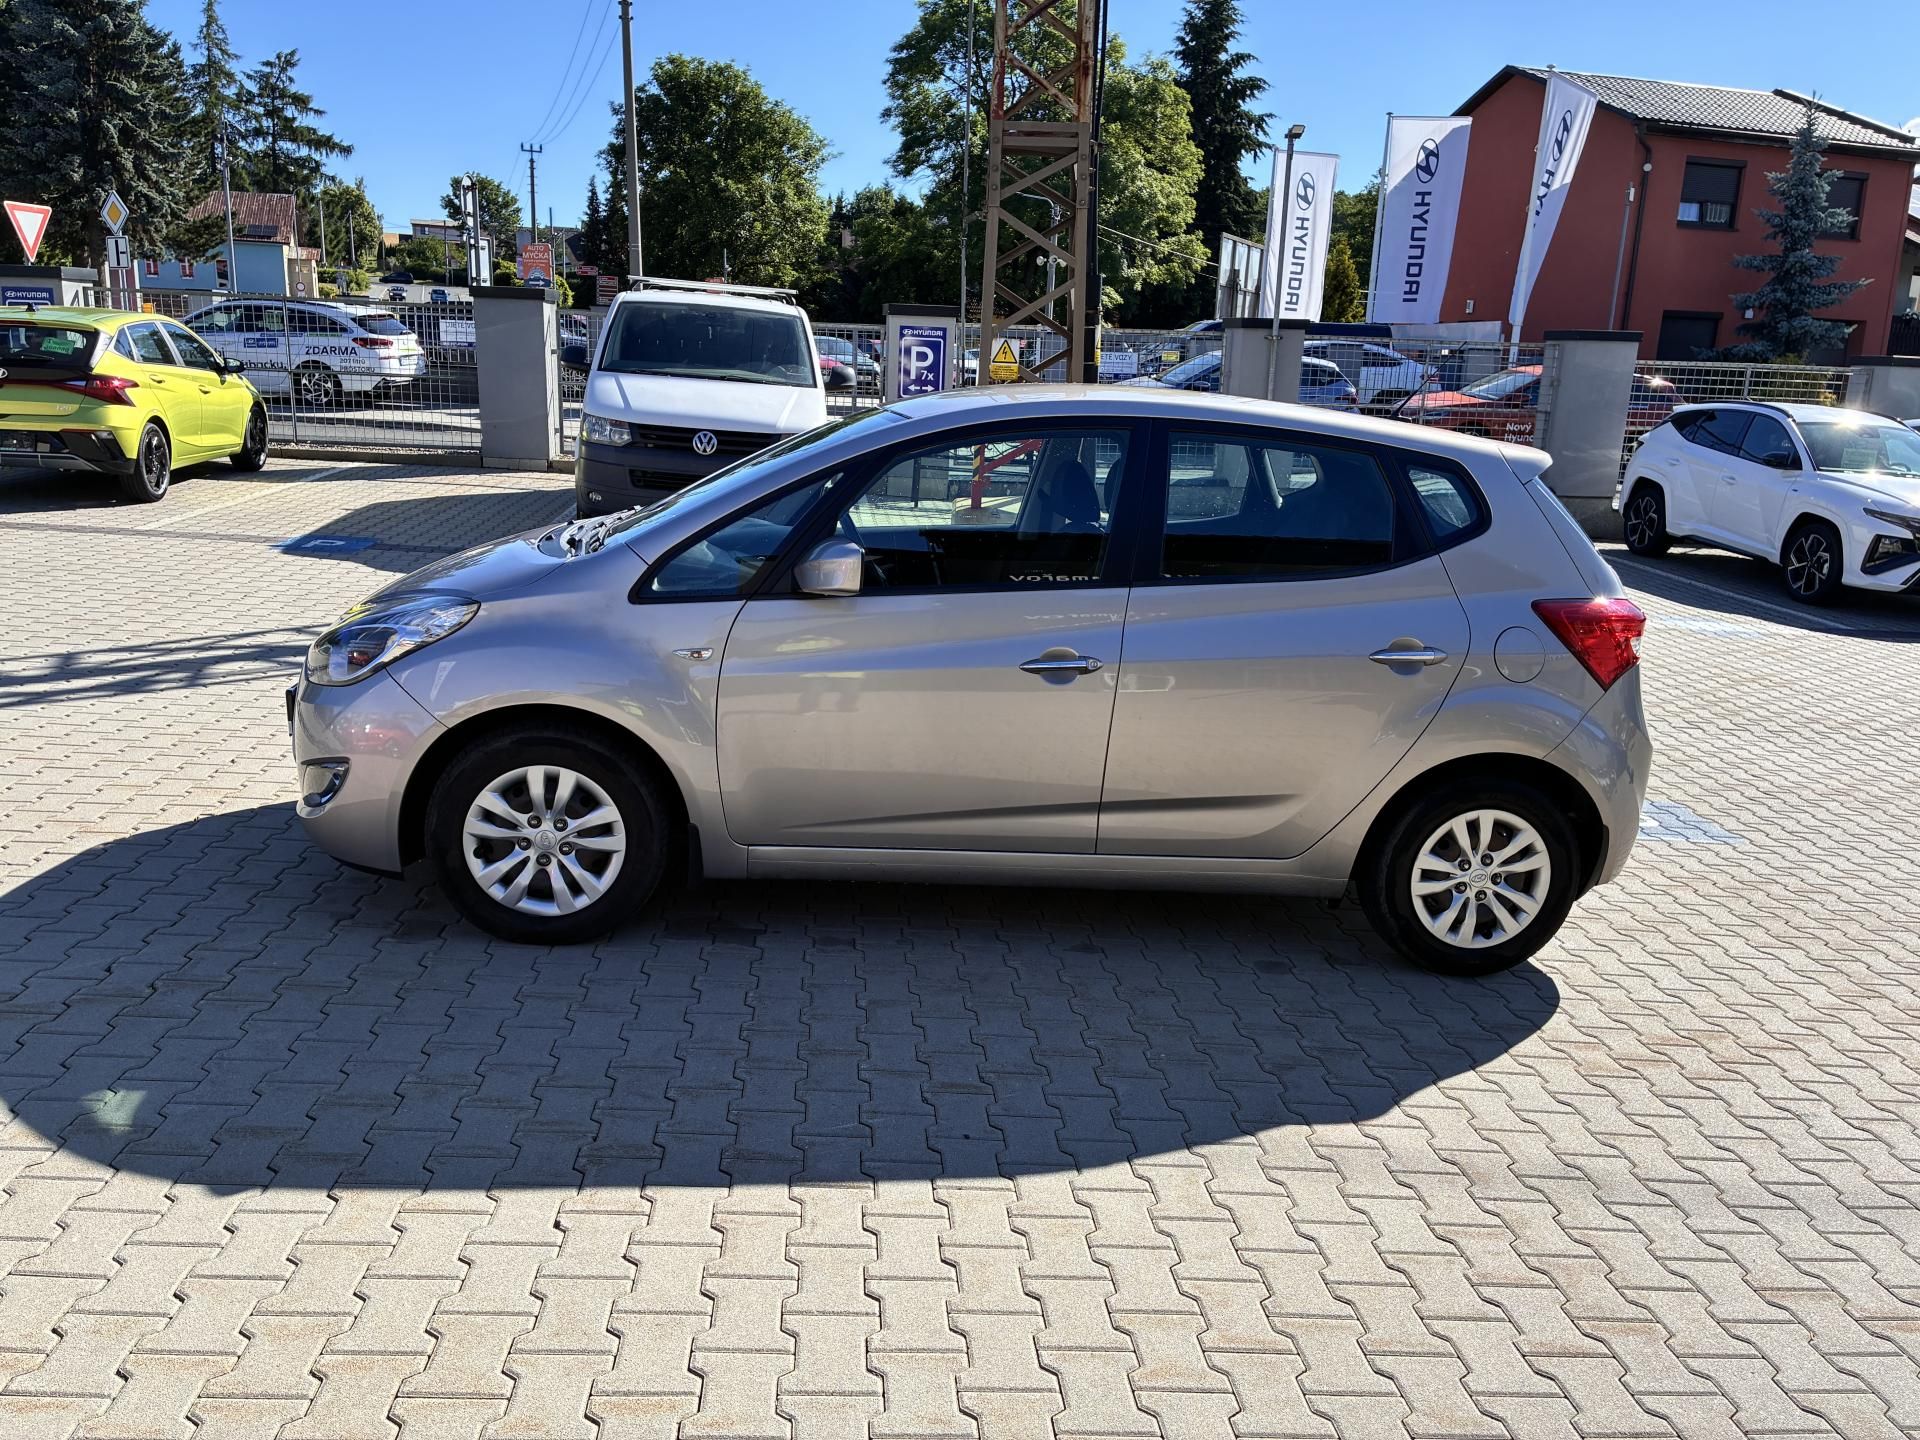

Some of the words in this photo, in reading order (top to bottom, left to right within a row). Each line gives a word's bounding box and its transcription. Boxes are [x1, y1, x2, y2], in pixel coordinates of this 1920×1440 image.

[1402, 191, 1432, 303] HYUNDAI
[522, 251, 549, 259] MYČKA
[1284, 216, 1310, 312] HYUNDAI
[305, 346, 358, 356] ZDARMA
[910, 345, 934, 380] P
[920, 370, 934, 381] 7x
[1506, 422, 1532, 432] Nový
